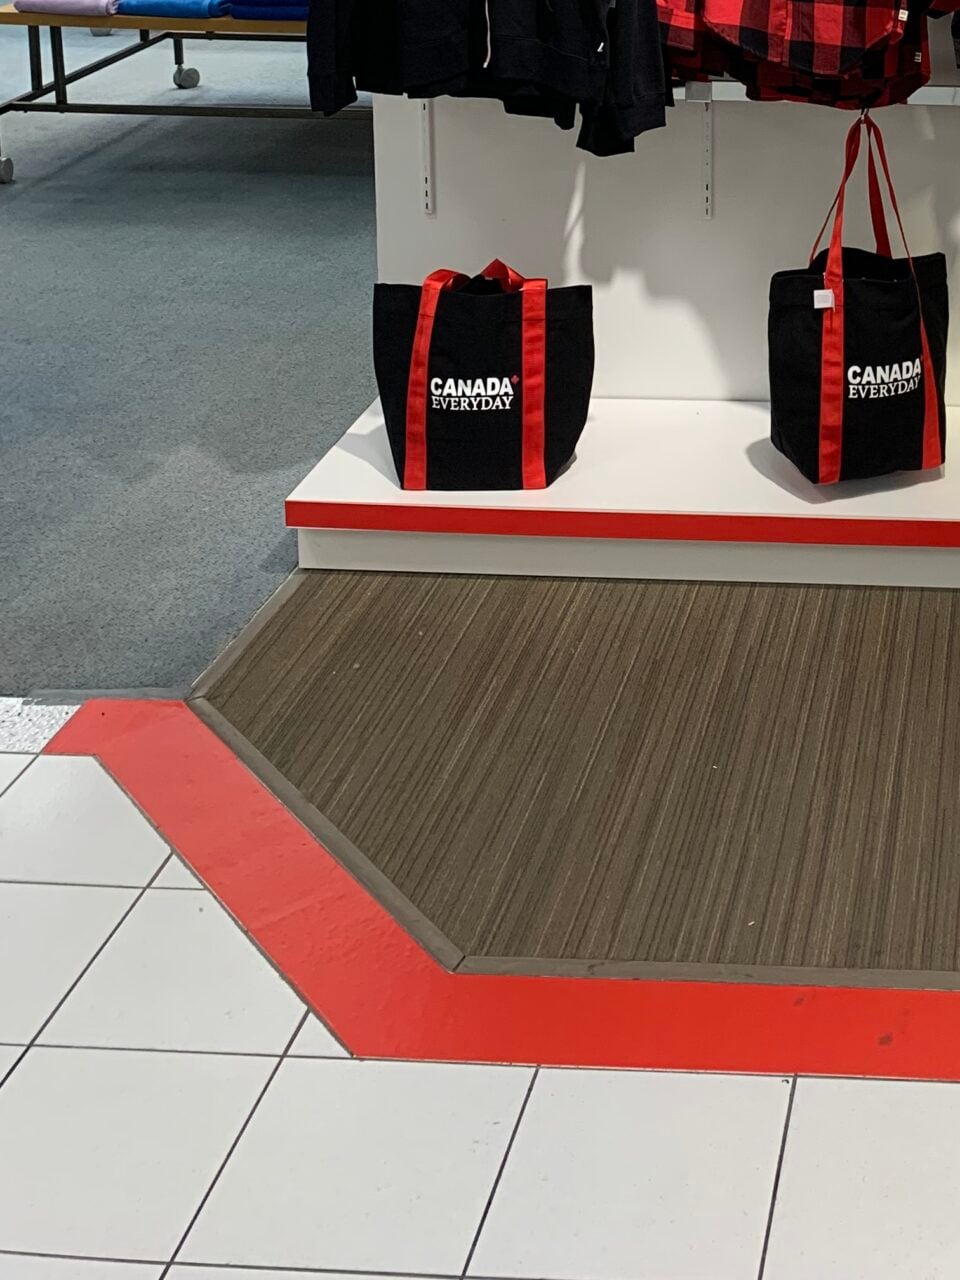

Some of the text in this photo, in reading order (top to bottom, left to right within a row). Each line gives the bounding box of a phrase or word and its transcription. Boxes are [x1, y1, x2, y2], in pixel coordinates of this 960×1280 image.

[847, 357, 922, 385] CANADA
[430, 376, 515, 397] CANADA
[848, 375, 921, 399] EVERYDAY
[431, 395, 514, 411] EVERYDAY
